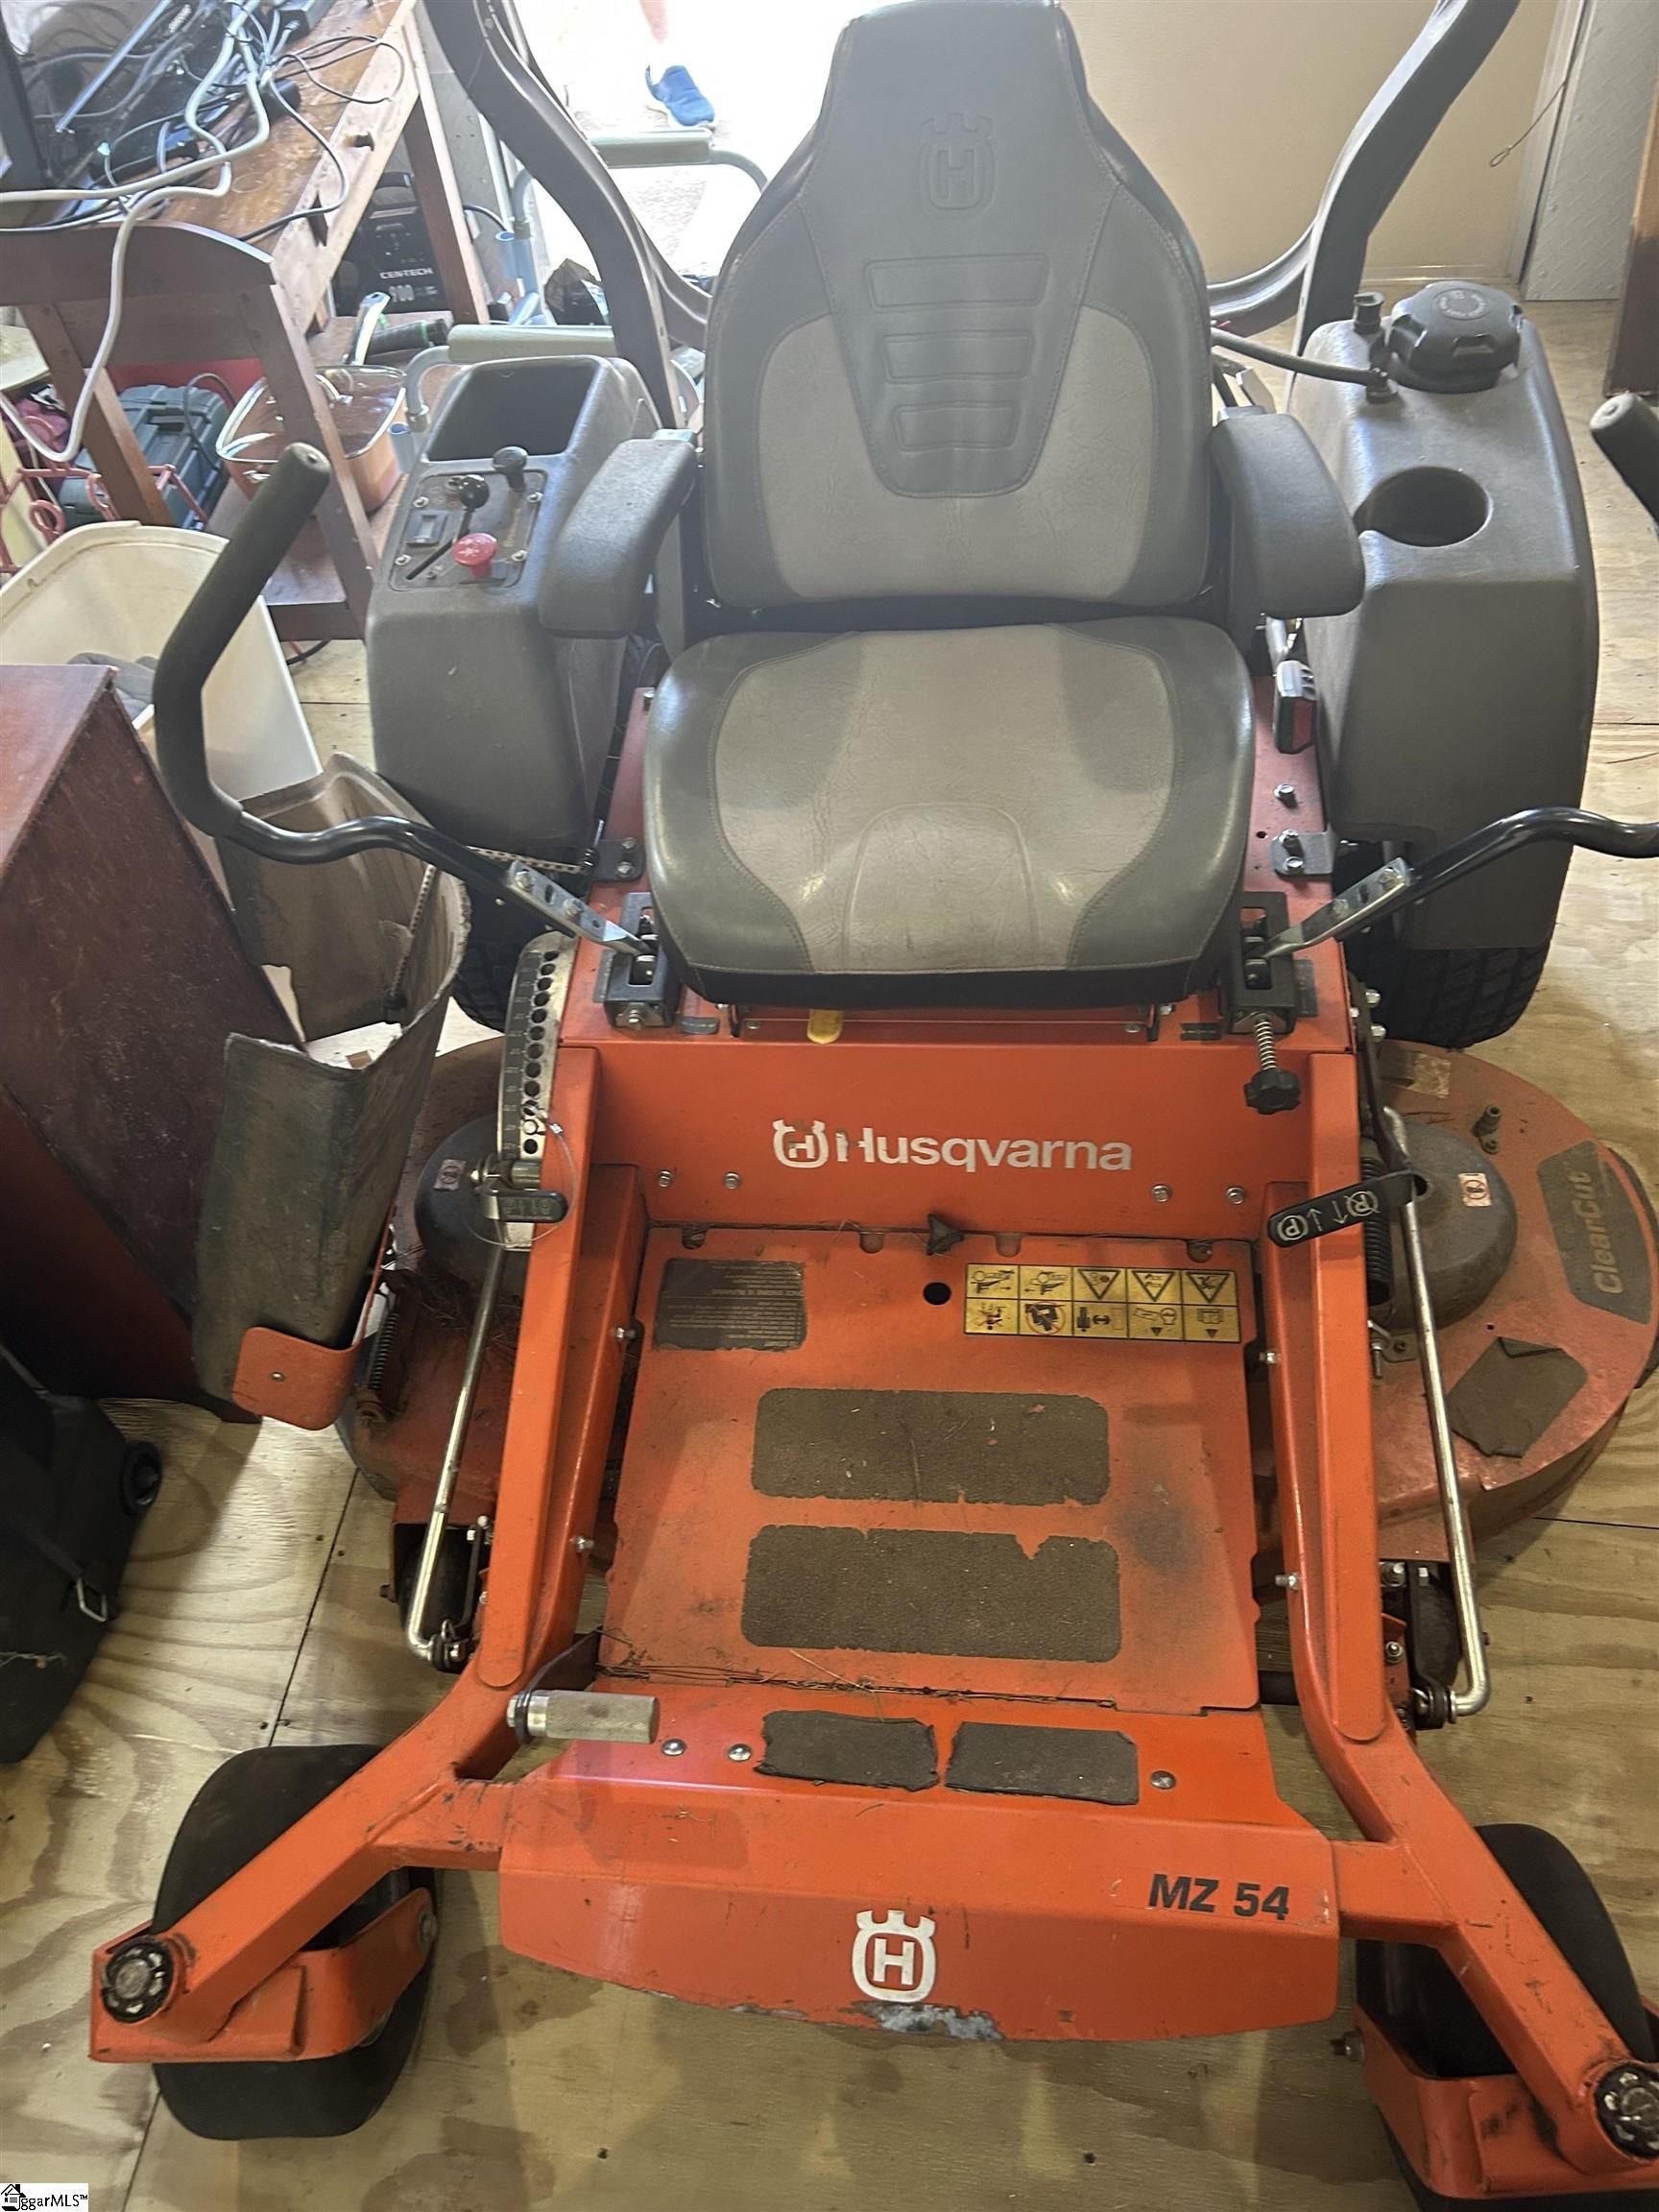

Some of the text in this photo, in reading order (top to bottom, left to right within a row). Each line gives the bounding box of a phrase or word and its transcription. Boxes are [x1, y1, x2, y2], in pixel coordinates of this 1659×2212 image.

[835, 1126, 1133, 1173] Husqvarna
[1567, 1170, 1623, 1294] ClearCut
[1148, 1872, 1290, 1921] MZ 54
